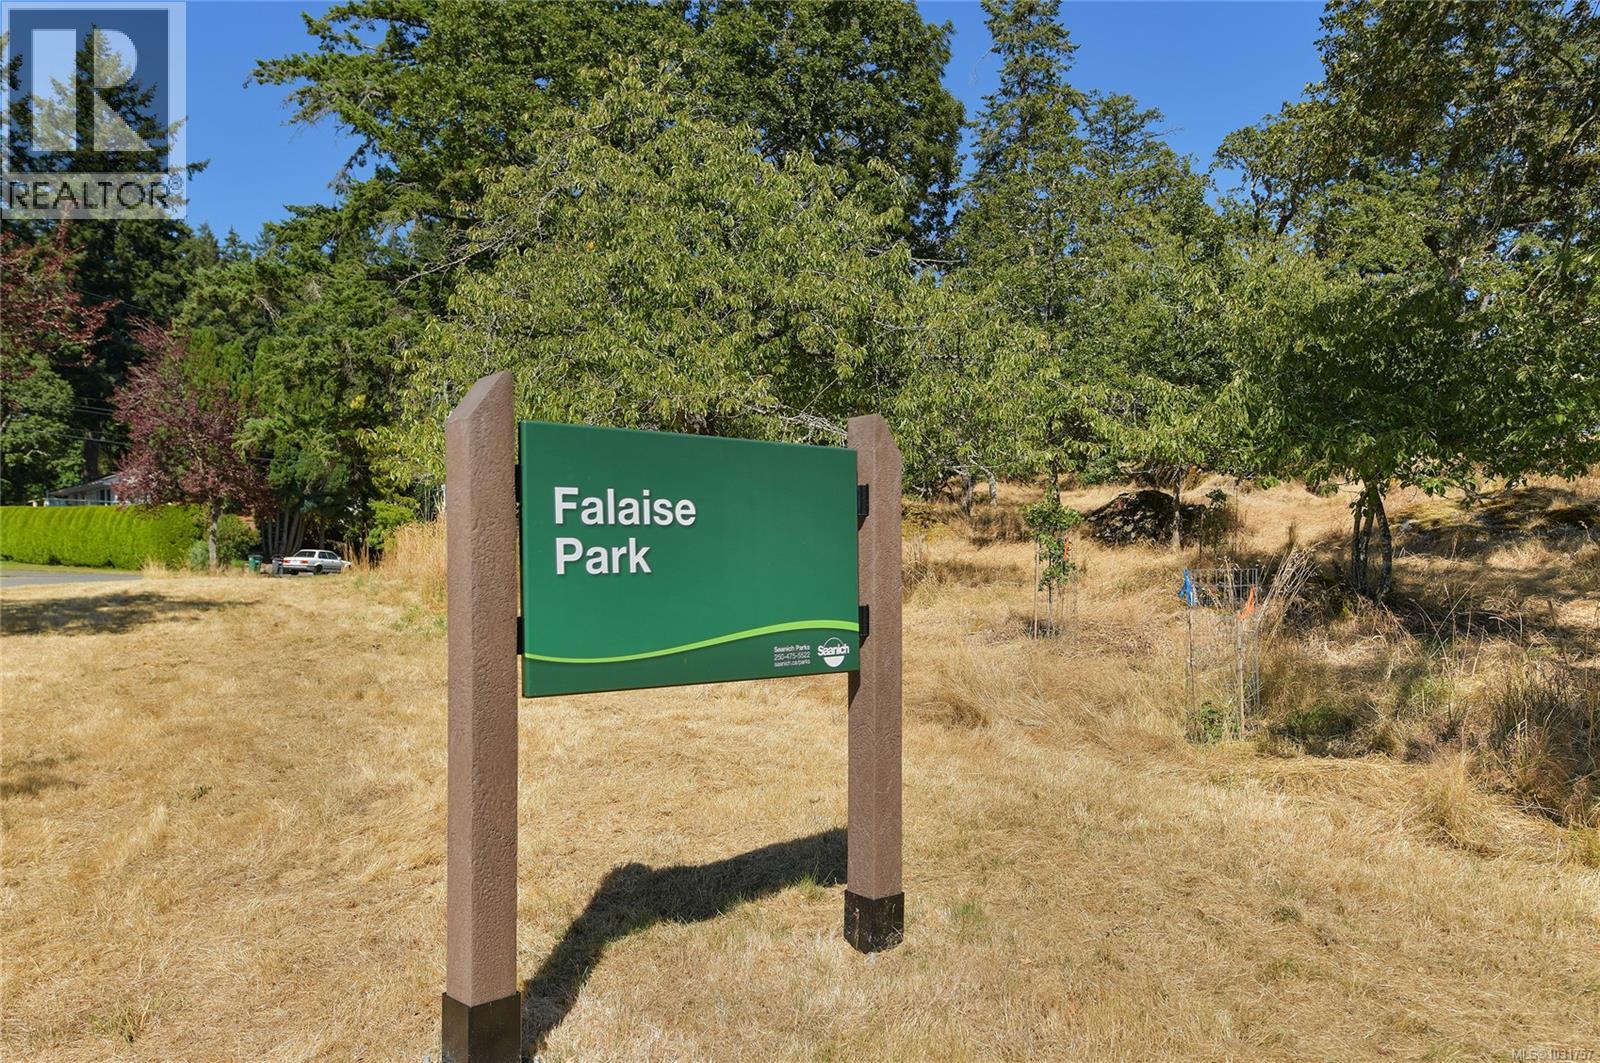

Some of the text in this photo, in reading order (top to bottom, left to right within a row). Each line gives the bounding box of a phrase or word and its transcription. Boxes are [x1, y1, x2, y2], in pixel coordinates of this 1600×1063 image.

[554, 486, 697, 526] Falaise
[555, 537, 652, 575] Park
[817, 643, 850, 656] Saanich
